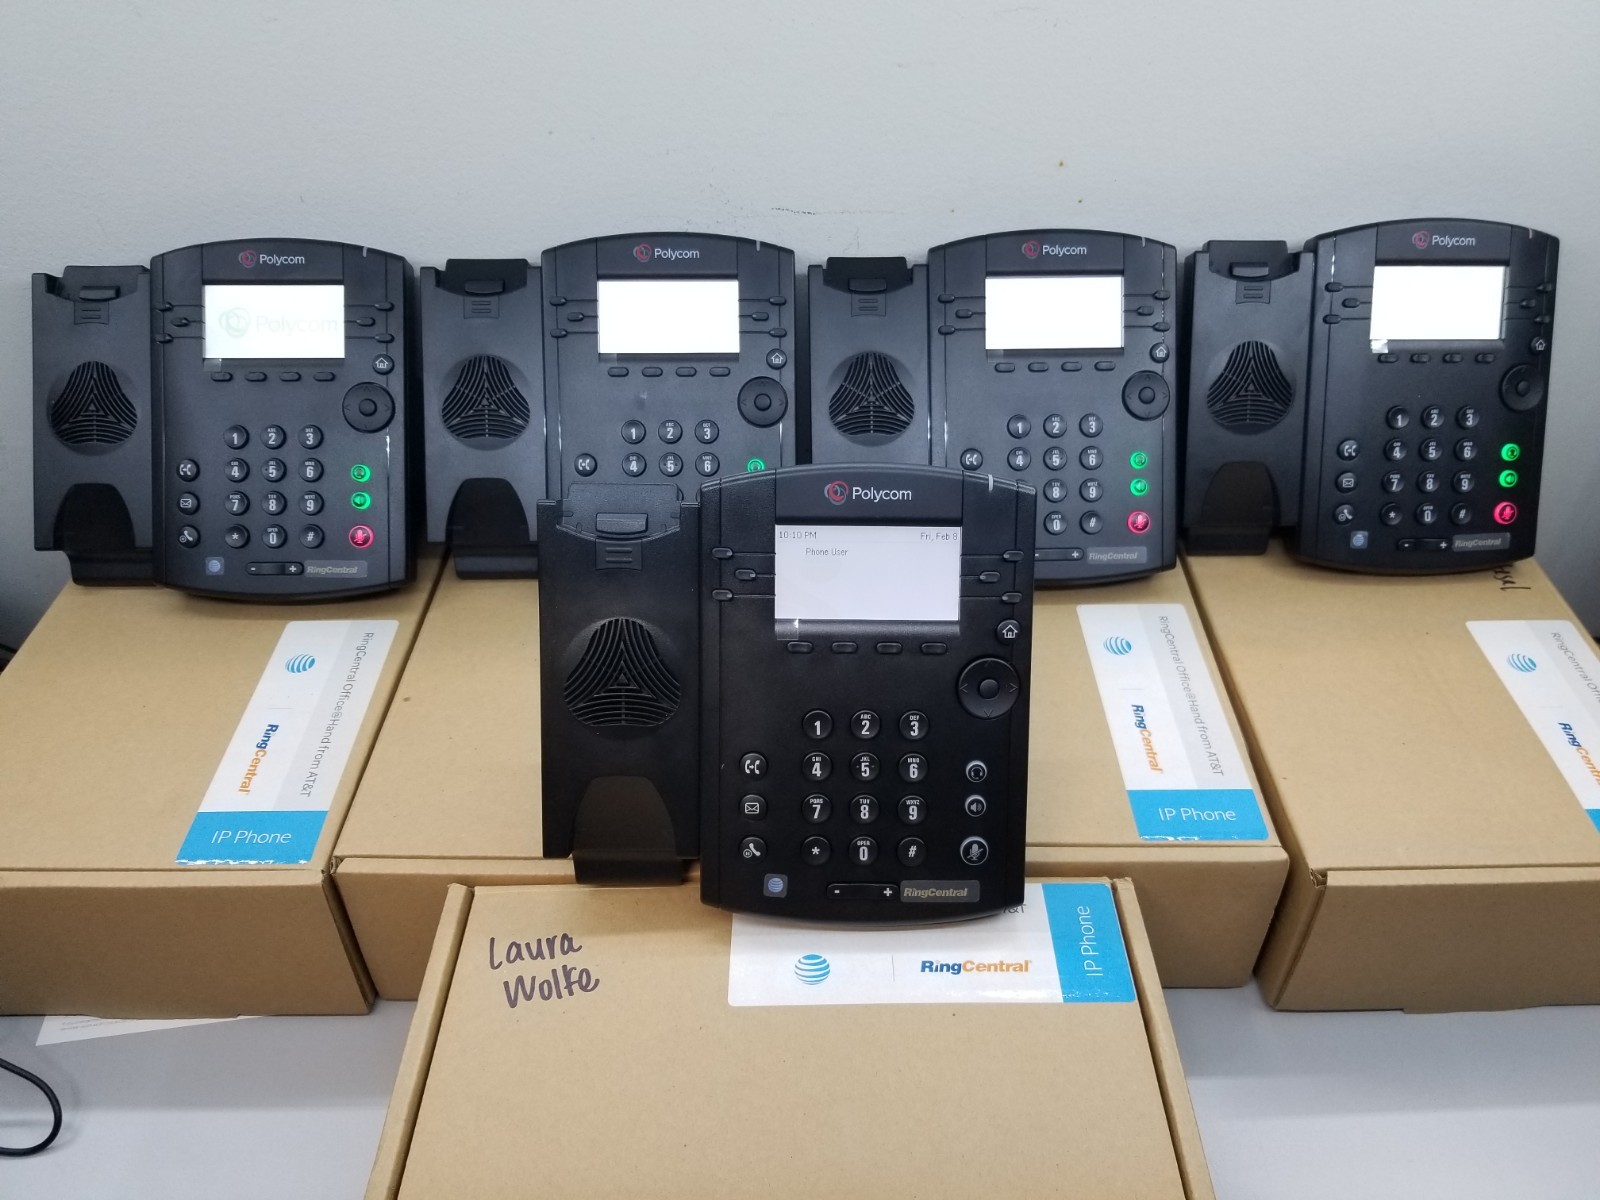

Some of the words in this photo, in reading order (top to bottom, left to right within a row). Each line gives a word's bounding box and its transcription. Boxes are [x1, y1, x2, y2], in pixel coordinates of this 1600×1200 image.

[1432, 235, 1476, 248] Polycom
[654, 248, 700, 260] Polycom
[1042, 245, 1087, 257] Polycom
[260, 254, 305, 266] Polycom
[1396, 414, 1402, 426] 1
[1431, 414, 1438, 426] 2
[1466, 414, 1473, 426] 3
[667, 427, 673, 439] 2
[1017, 422, 1022, 434] 1
[1052, 422, 1060, 433] 2
[1089, 421, 1096, 433] 3
[232, 433, 238, 445] 1
[268, 433, 276, 444] 2
[306, 433, 314, 445] 3
[630, 428, 636, 439] 1
[704, 428, 711, 439] 3
[1393, 447, 1400, 458] 4
[1429, 446, 1436, 458] 5
[1464, 446, 1471, 458] 6
[630, 460, 638, 472] 4
[667, 460, 674, 472] 5
[1016, 455, 1024, 467] 4
[1052, 455, 1060, 466] 5
[1089, 454, 1096, 466] 6
[231, 466, 239, 478] 4
[268, 466, 276, 477] 5
[306, 466, 314, 478] 6
[704, 461, 711, 472] 6
[1391, 479, 1398, 491] 7
[1426, 478, 1433, 490] 8
[1461, 479, 1468, 490] 9
[852, 487, 912, 502] Polycom
[1052, 487, 1060, 498] 8
[1089, 487, 1096, 498] 9
[231, 500, 239, 511] 7
[269, 499, 276, 511] 8
[306, 500, 314, 511] 9
[1424, 510, 1431, 522] 0
[1053, 519, 1060, 531] 0
[269, 533, 277, 544] 0
[779, 531, 802, 539] 10:10
[804, 531, 817, 539] PM
[935, 532, 950, 541] Feb
[952, 533, 958, 541] 8
[805, 548, 829, 556] Phone
[831, 548, 848, 556] User
[346, 632, 374, 682] RingCentral
[1551, 632, 1593, 681] RingCentral
[1158, 615, 1181, 664] RingCentral
[1176, 665, 1204, 724] Office@Hand
[1195, 725, 1212, 750] from
[1206, 751, 1224, 776] AT&T
[321, 683, 352, 745] Office@Hand
[814, 720, 821, 735] 1
[861, 720, 870, 735] 2
[910, 721, 919, 736] 3
[1131, 704, 1163, 773] RingCentral
[238, 723, 279, 793] RingCentral
[311, 746, 330, 770] from
[811, 762, 822, 777] 4
[861, 762, 870, 777] 5
[909, 764, 918, 778] 6
[300, 771, 319, 797] AT&T
[812, 805, 821, 819] 7
[860, 804, 869, 819] 8
[909, 805, 918, 820] 9
[1158, 807, 1176, 821] IP
[1180, 807, 1236, 821] Phone
[211, 830, 232, 844] IP
[234, 829, 292, 844] Phone
[859, 846, 868, 861] 0
[904, 888, 968, 898] RingCentral
[1077, 905, 1099, 955] Phone
[489, 932, 583, 970] Laura
[920, 960, 1033, 976] RingCentral
[1083, 960, 1103, 976] IP
[503, 964, 600, 1008] Wolfe
